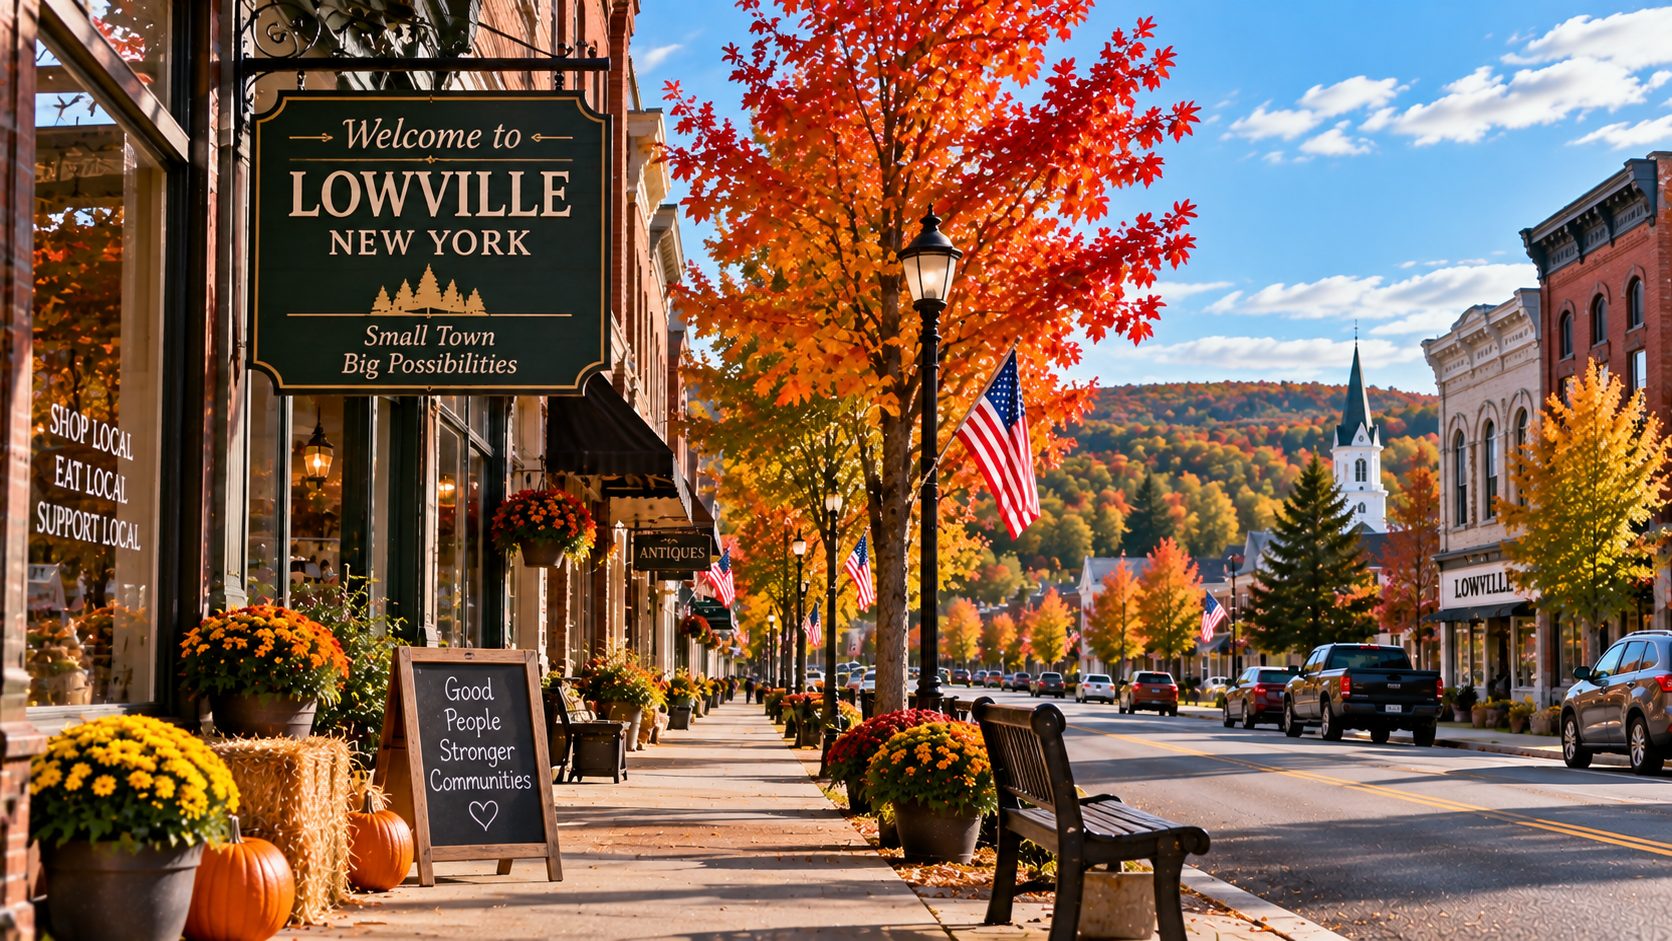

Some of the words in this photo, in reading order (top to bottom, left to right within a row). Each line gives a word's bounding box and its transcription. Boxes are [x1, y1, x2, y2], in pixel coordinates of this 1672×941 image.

[342, 117, 482, 149] Welcome
[493, 123, 522, 149] to
[288, 170, 572, 217] LOWVILLE
[329, 229, 415, 256] NEW
[427, 229, 531, 256] YORK
[364, 324, 428, 346] Small
[436, 325, 495, 346] Town
[341, 352, 380, 380] Big
[387, 352, 518, 375] Possibilities
[50, 403, 89, 444] SHOP
[92, 419, 134, 461] LOCAL
[54, 455, 83, 492] EAT
[85, 464, 129, 504] LOCAL
[36, 500, 100, 543] SUPPORT
[102, 516, 141, 551] LOCAL
[639, 546, 705, 561] ANTIQUES
[444, 676, 495, 701] Good
[443, 707, 502, 738] People
[439, 738, 515, 768] Stronger
[430, 768, 532, 792] Communities
